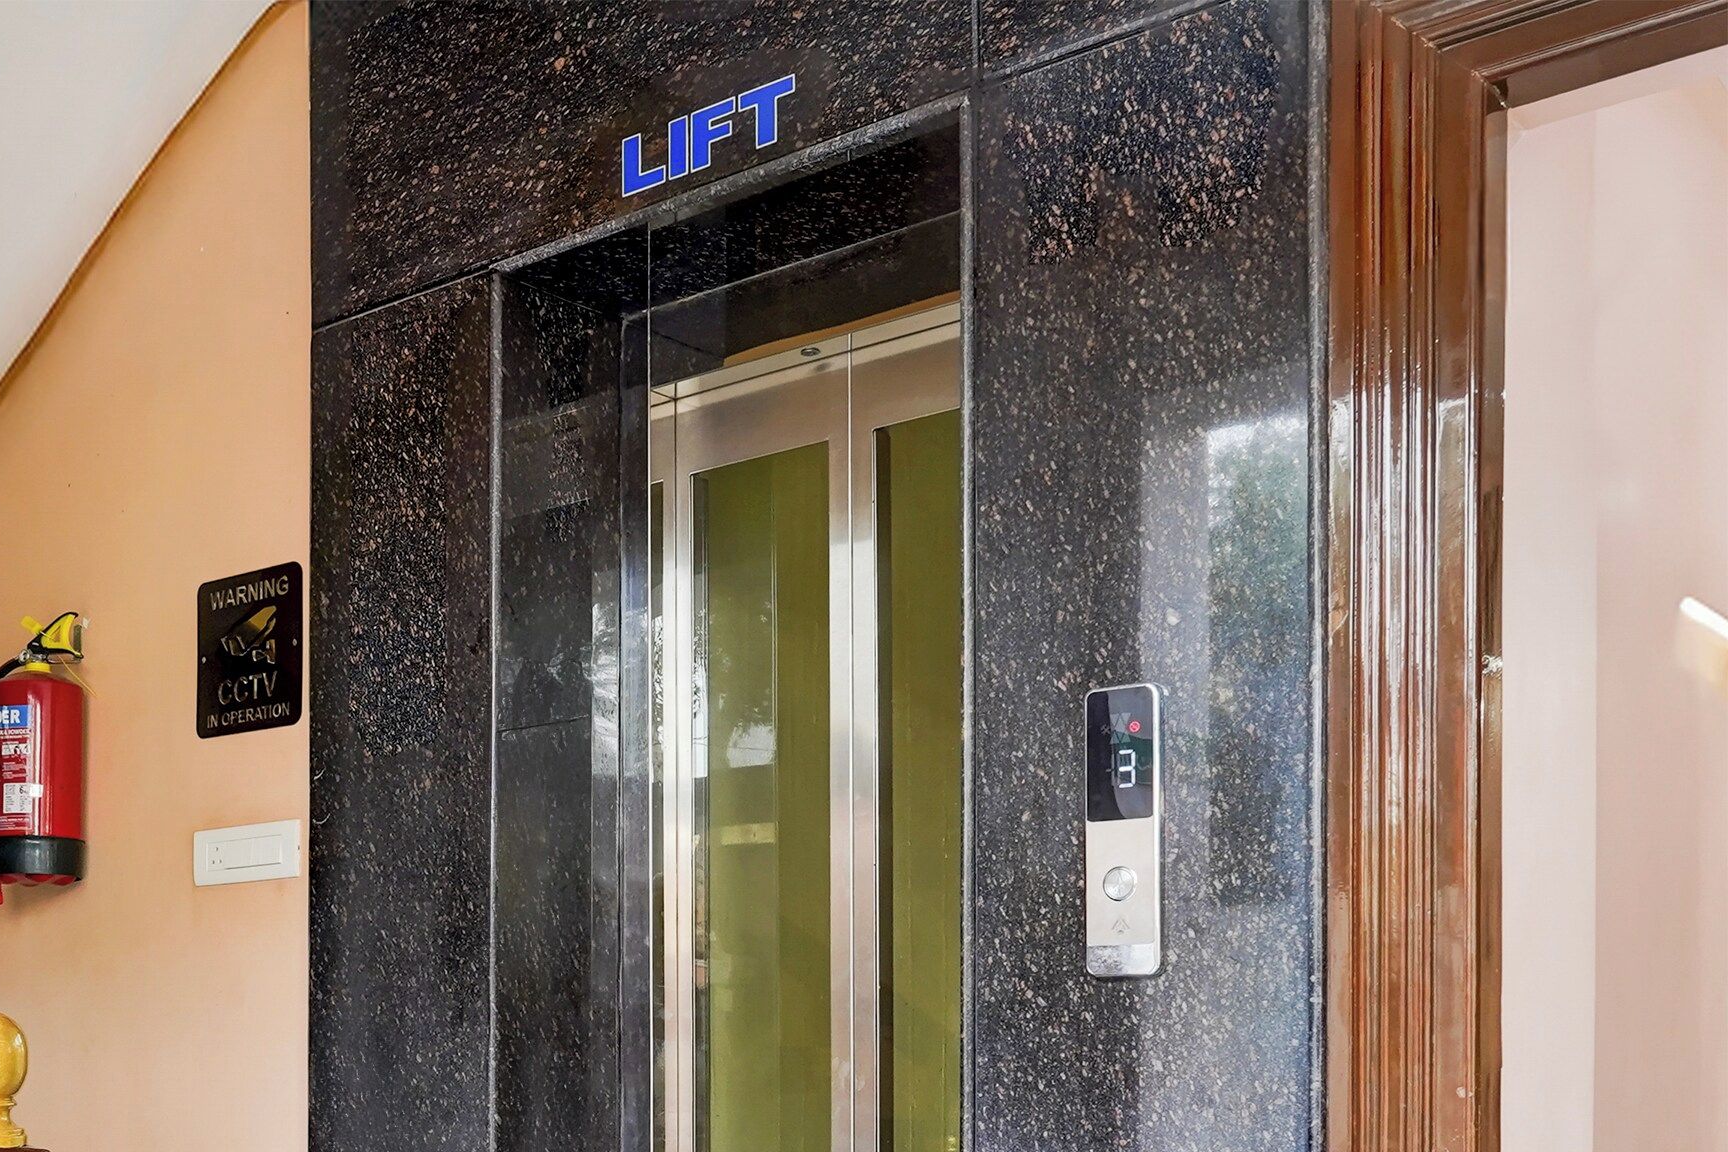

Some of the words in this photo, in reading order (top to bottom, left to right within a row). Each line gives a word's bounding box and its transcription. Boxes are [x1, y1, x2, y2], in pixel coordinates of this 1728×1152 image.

[622, 74, 796, 198] LIFT
[210, 576, 289, 611] WARNING
[218, 671, 278, 705] CCTV
[207, 714, 219, 729] IN
[222, 702, 290, 726] OPERATION
[1118, 749, 1136, 788] 3
